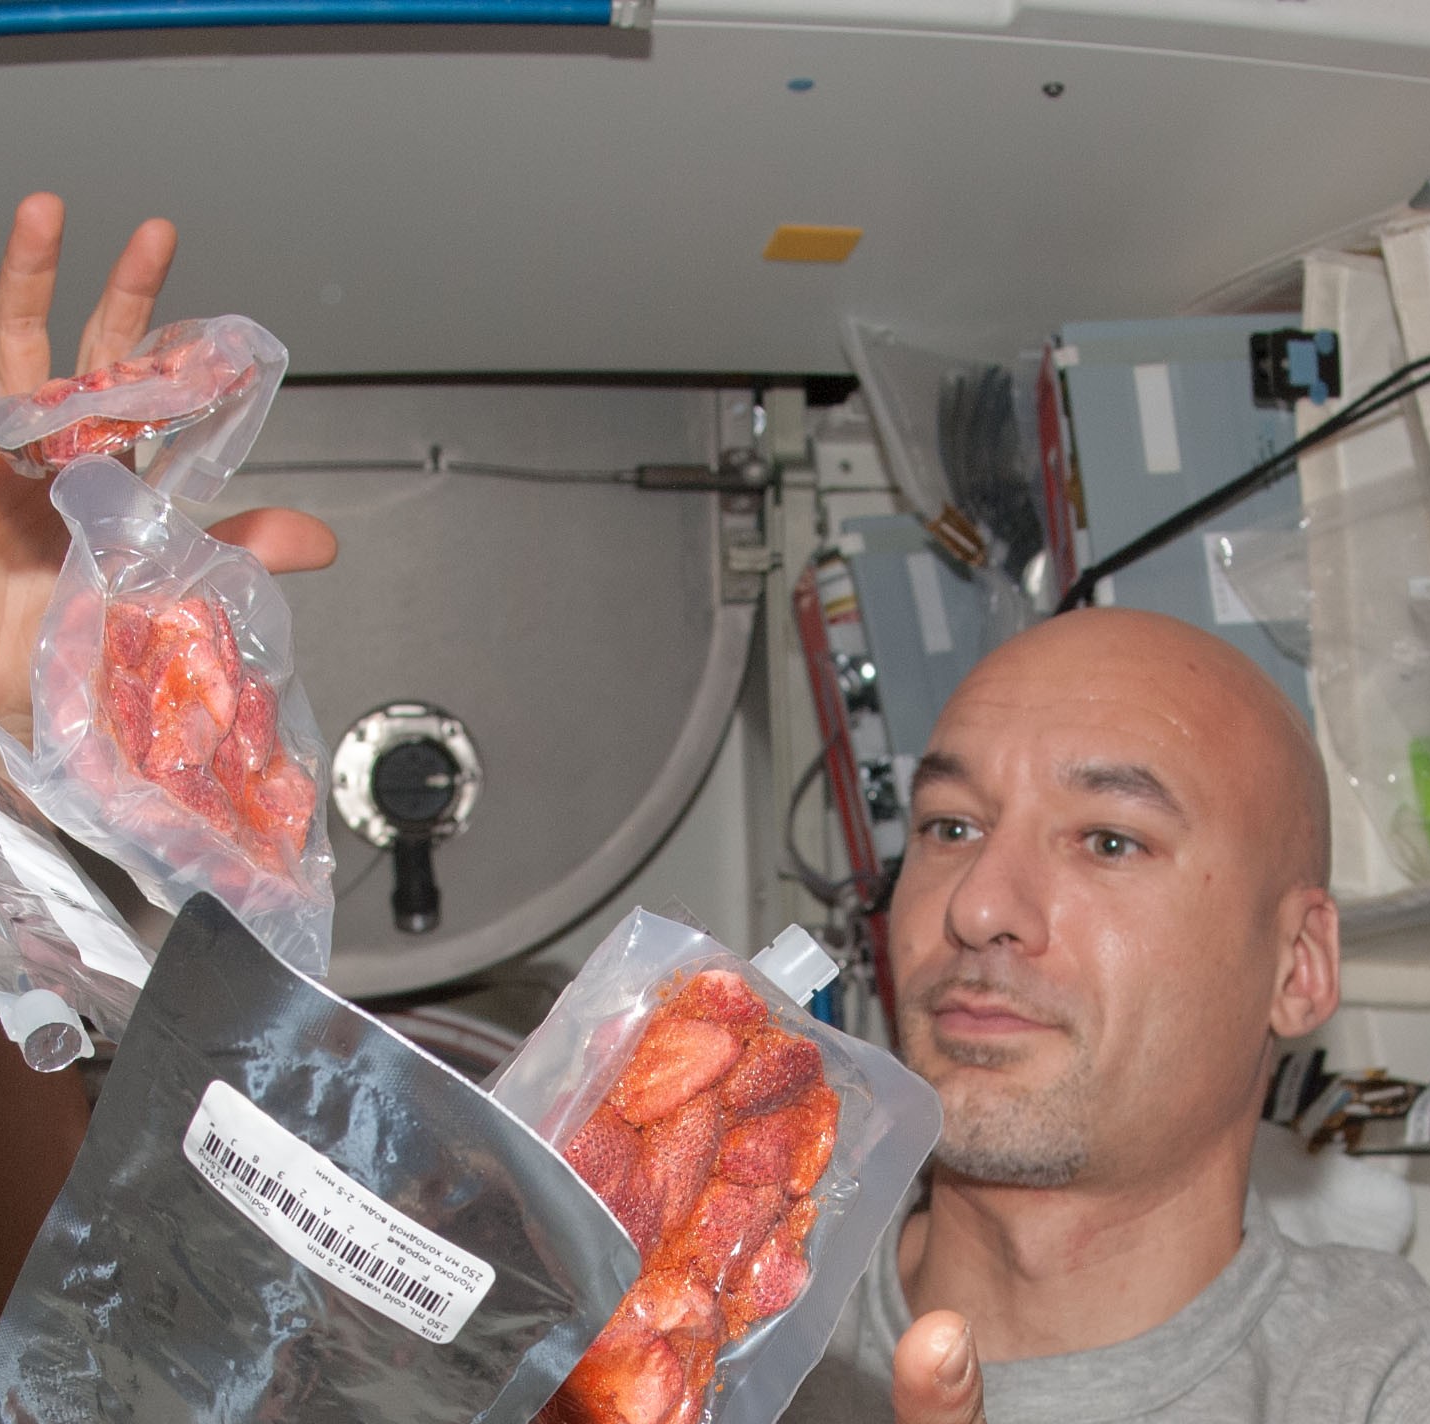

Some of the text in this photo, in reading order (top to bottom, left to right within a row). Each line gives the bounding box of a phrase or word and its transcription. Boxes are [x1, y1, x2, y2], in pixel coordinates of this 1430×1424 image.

[337, 1186, 354, 1202] 2-5
[307, 1243, 325, 1259] min
[327, 1258, 345, 1273] 2-5
[462, 1266, 483, 1282] 250
[383, 1293, 406, 1308] cold
[410, 1306, 425, 1319] mL
[427, 1318, 448, 1332] 250
